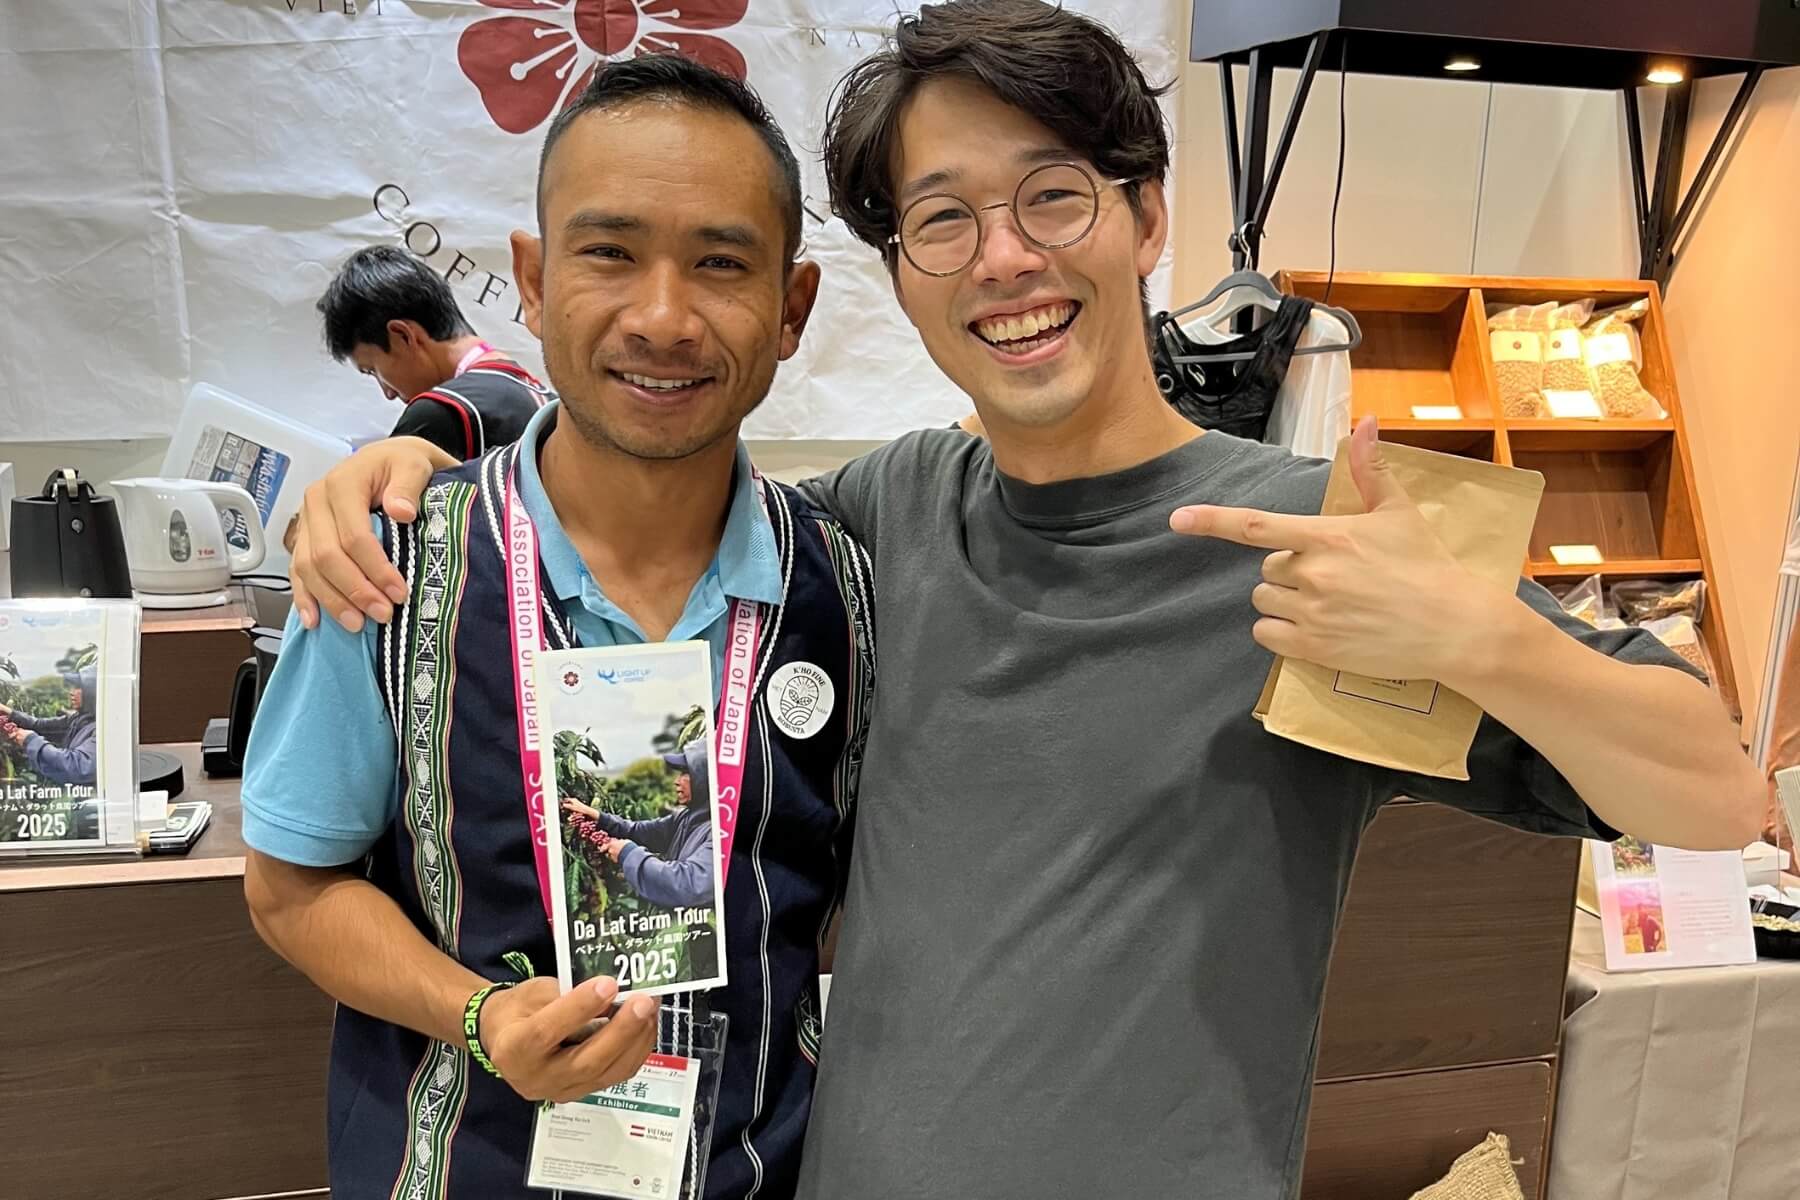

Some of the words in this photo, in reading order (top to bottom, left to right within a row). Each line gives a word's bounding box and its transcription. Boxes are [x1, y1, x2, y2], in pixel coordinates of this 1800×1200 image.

[810, 28, 885, 48] NA
[513, 514, 535, 640] Association
[731, 667, 746, 691] of
[721, 696, 745, 758] Japan
[7, 785, 27, 800] Lat
[29, 784, 62, 799] Farm
[64, 783, 94, 798] Tour
[17, 813, 66, 838] 2025
[717, 785, 737, 858] SCA
[574, 919, 596, 941] Da
[600, 915, 626, 937] Lat
[629, 912, 671, 932] Farm
[674, 906, 712, 926] Tour
[614, 947, 677, 986] 2025
[603, 1080, 649, 1099] 展者
[597, 1098, 639, 1110] Exhibitor
